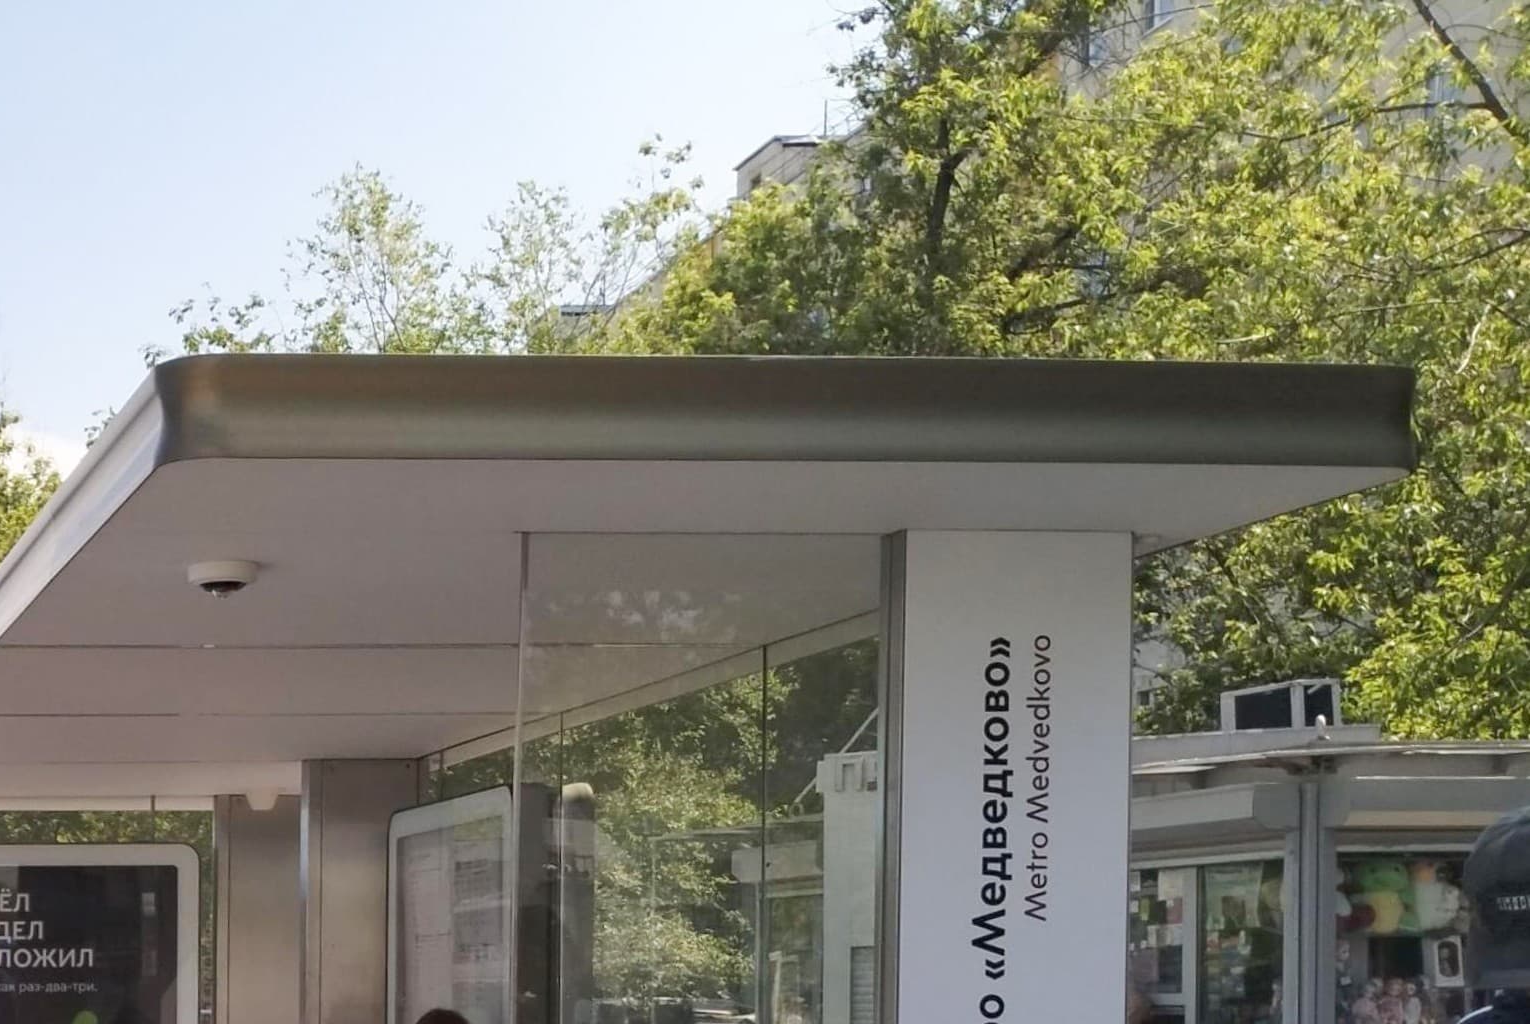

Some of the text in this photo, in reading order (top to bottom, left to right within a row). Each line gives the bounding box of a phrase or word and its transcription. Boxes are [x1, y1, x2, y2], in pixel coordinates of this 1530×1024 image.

[971, 636, 1013, 981] «Медведково»
[1024, 634, 1052, 922] Metro Medvedkovo
[19, 981, 98, 993] раз-два-три.
